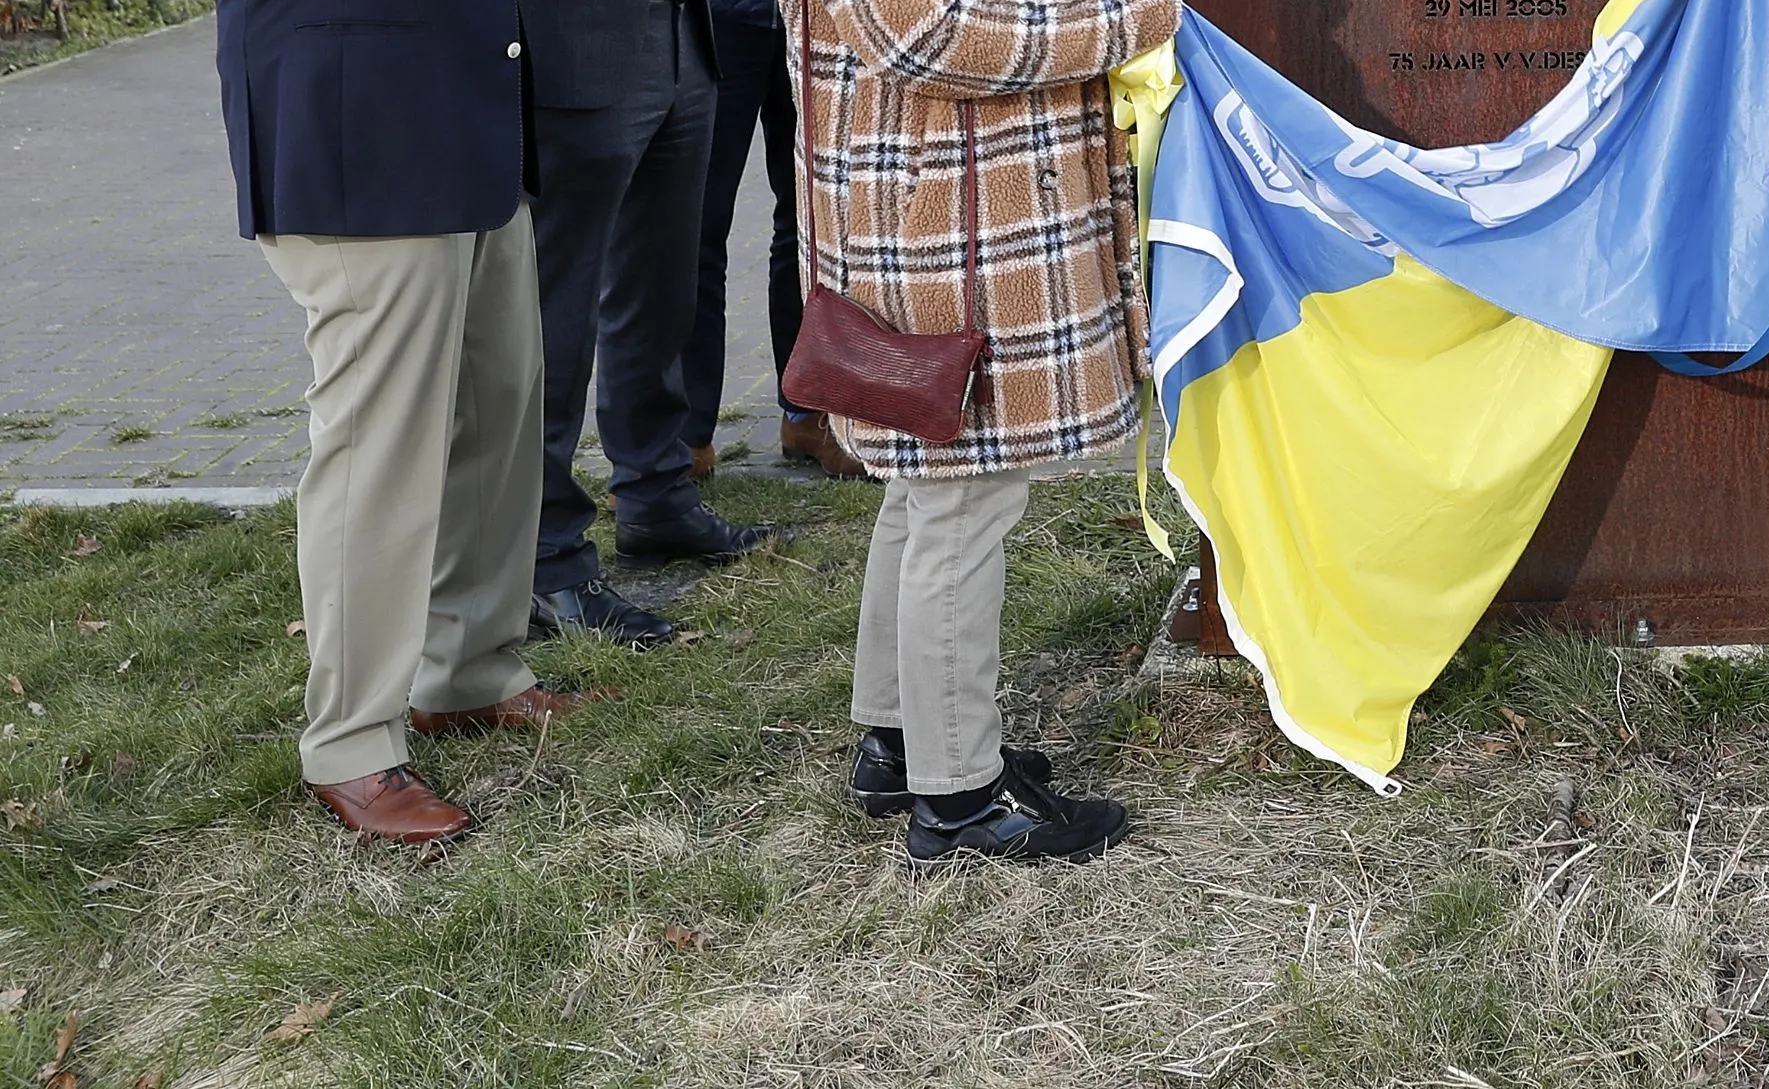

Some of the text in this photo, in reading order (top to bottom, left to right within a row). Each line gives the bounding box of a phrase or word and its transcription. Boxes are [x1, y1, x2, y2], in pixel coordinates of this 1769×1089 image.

[1425, 0, 1451, 17] 29
[1459, 0, 1497, 17] MEI
[1388, 52, 1414, 70] 75
[1422, 52, 1485, 70] JAAR
